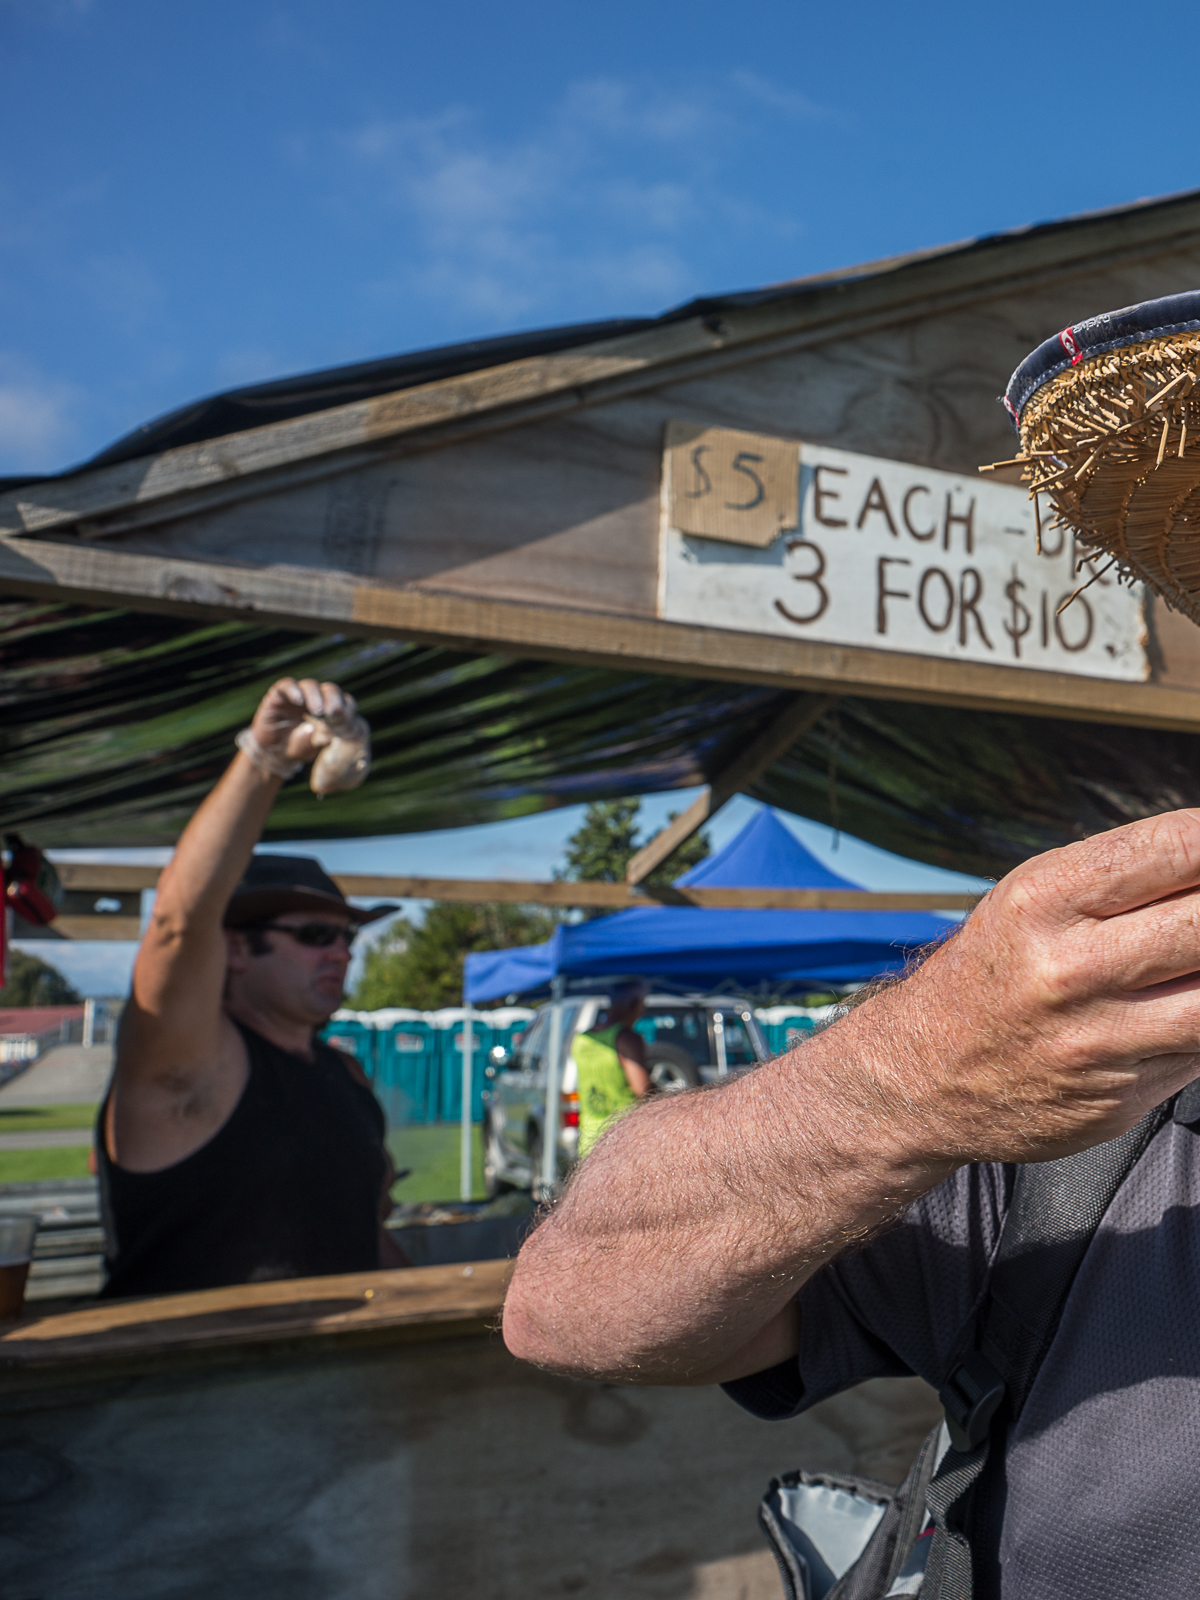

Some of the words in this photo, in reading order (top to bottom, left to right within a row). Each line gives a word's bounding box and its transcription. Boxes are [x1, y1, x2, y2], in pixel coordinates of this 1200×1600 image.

[813, 465, 978, 556] EACH
[773, 538, 831, 626] 3
[876, 555, 993, 651] FOR
